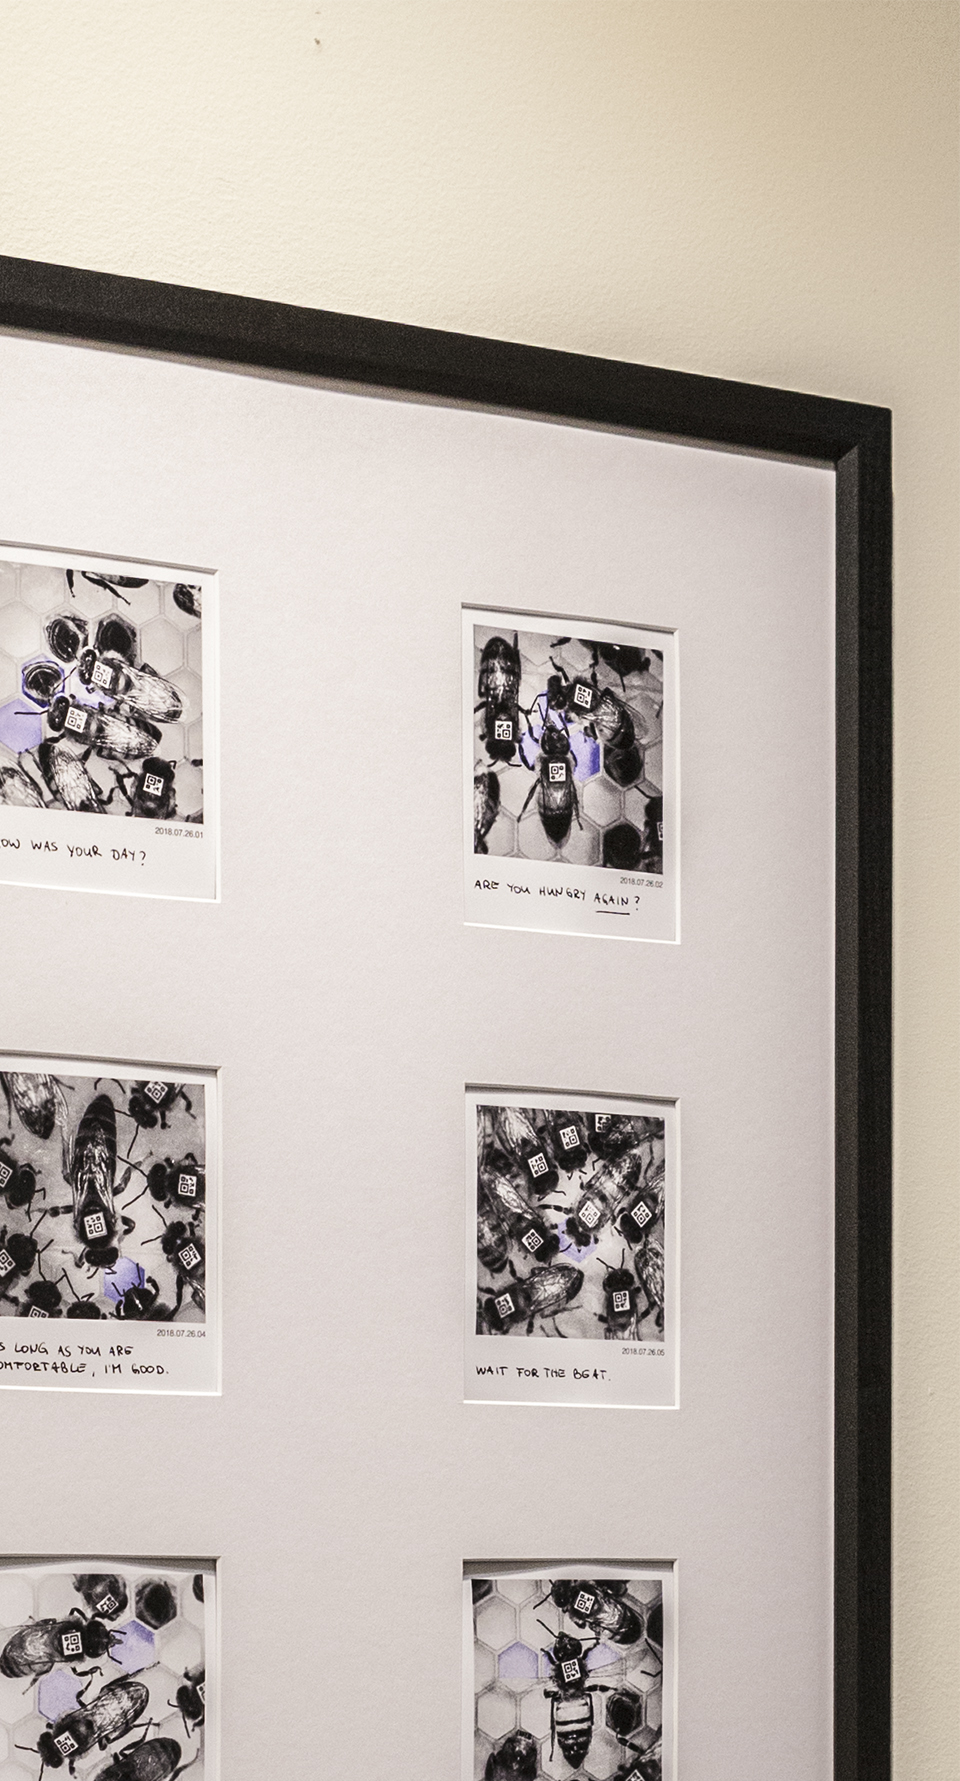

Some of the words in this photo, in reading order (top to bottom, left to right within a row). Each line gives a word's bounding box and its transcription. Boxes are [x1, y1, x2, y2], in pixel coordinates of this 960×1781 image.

[155, 827, 203, 838] 2018.07.26.01
[31, 840, 58, 852] WAS
[67, 845, 102, 857] YOUR
[111, 848, 146, 866] DAY?
[620, 877, 663, 888] 2018.07.26.02
[474, 879, 499, 890] ARE
[507, 884, 531, 894] YOU
[539, 886, 586, 901] HUNGRY
[157, 1329, 206, 1338] 2018.07.26.04
[15, 1342, 48, 1355] LONG
[58, 1345, 71, 1357] AS
[77, 1345, 101, 1356] YOU
[109, 1345, 133, 1356] ARE
[622, 1348, 665, 1356] 2018.07.26.05
[105, 1364, 122, 1374] I'M
[131, 1363, 169, 1374] GOOD.
[476, 1366, 508, 1375] WAIT
[516, 1367, 539, 1378] FOR
[543, 1368, 565, 1378] THE
